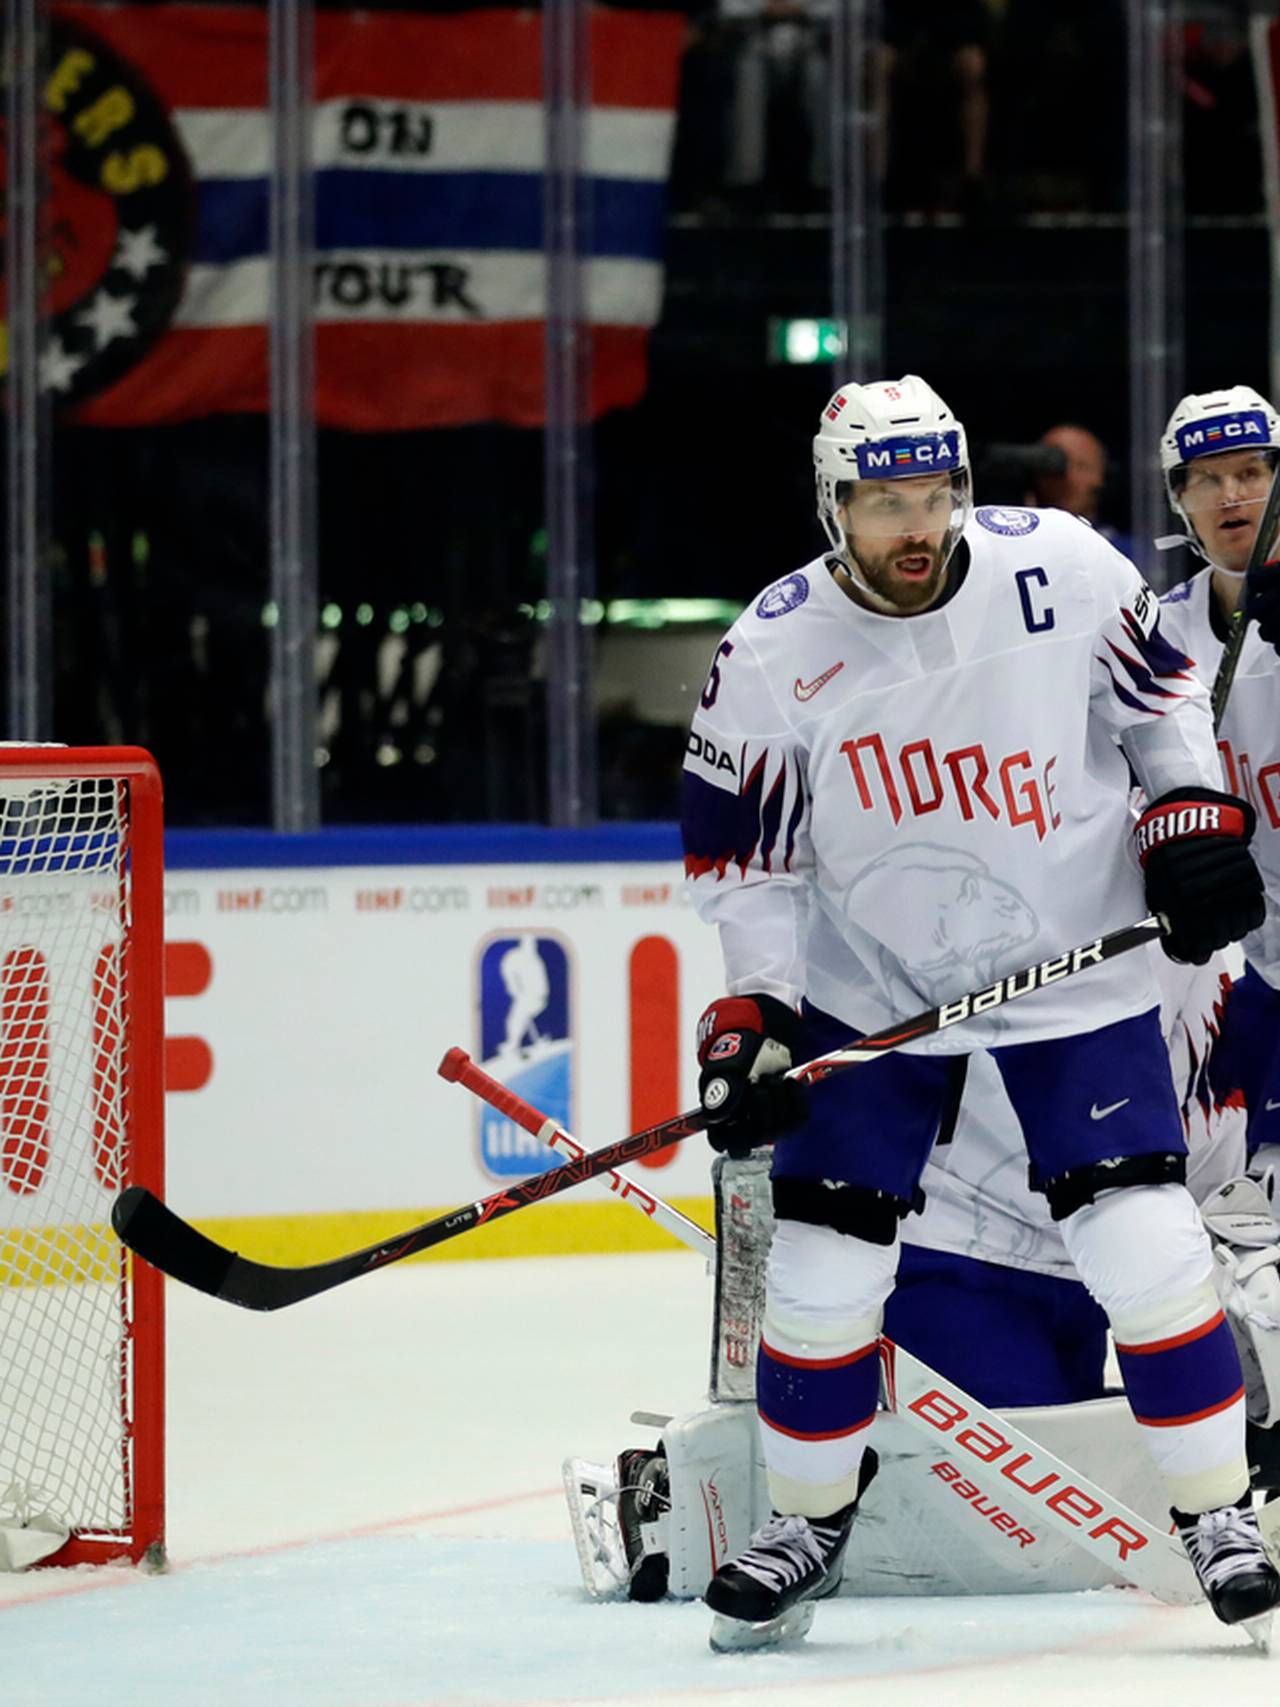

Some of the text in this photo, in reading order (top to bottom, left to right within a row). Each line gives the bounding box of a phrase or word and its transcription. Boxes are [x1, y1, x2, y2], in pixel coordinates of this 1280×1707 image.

[341, 104, 434, 155] ON
[1015, 566, 1056, 634] C
[838, 730, 1063, 843] NORGE
